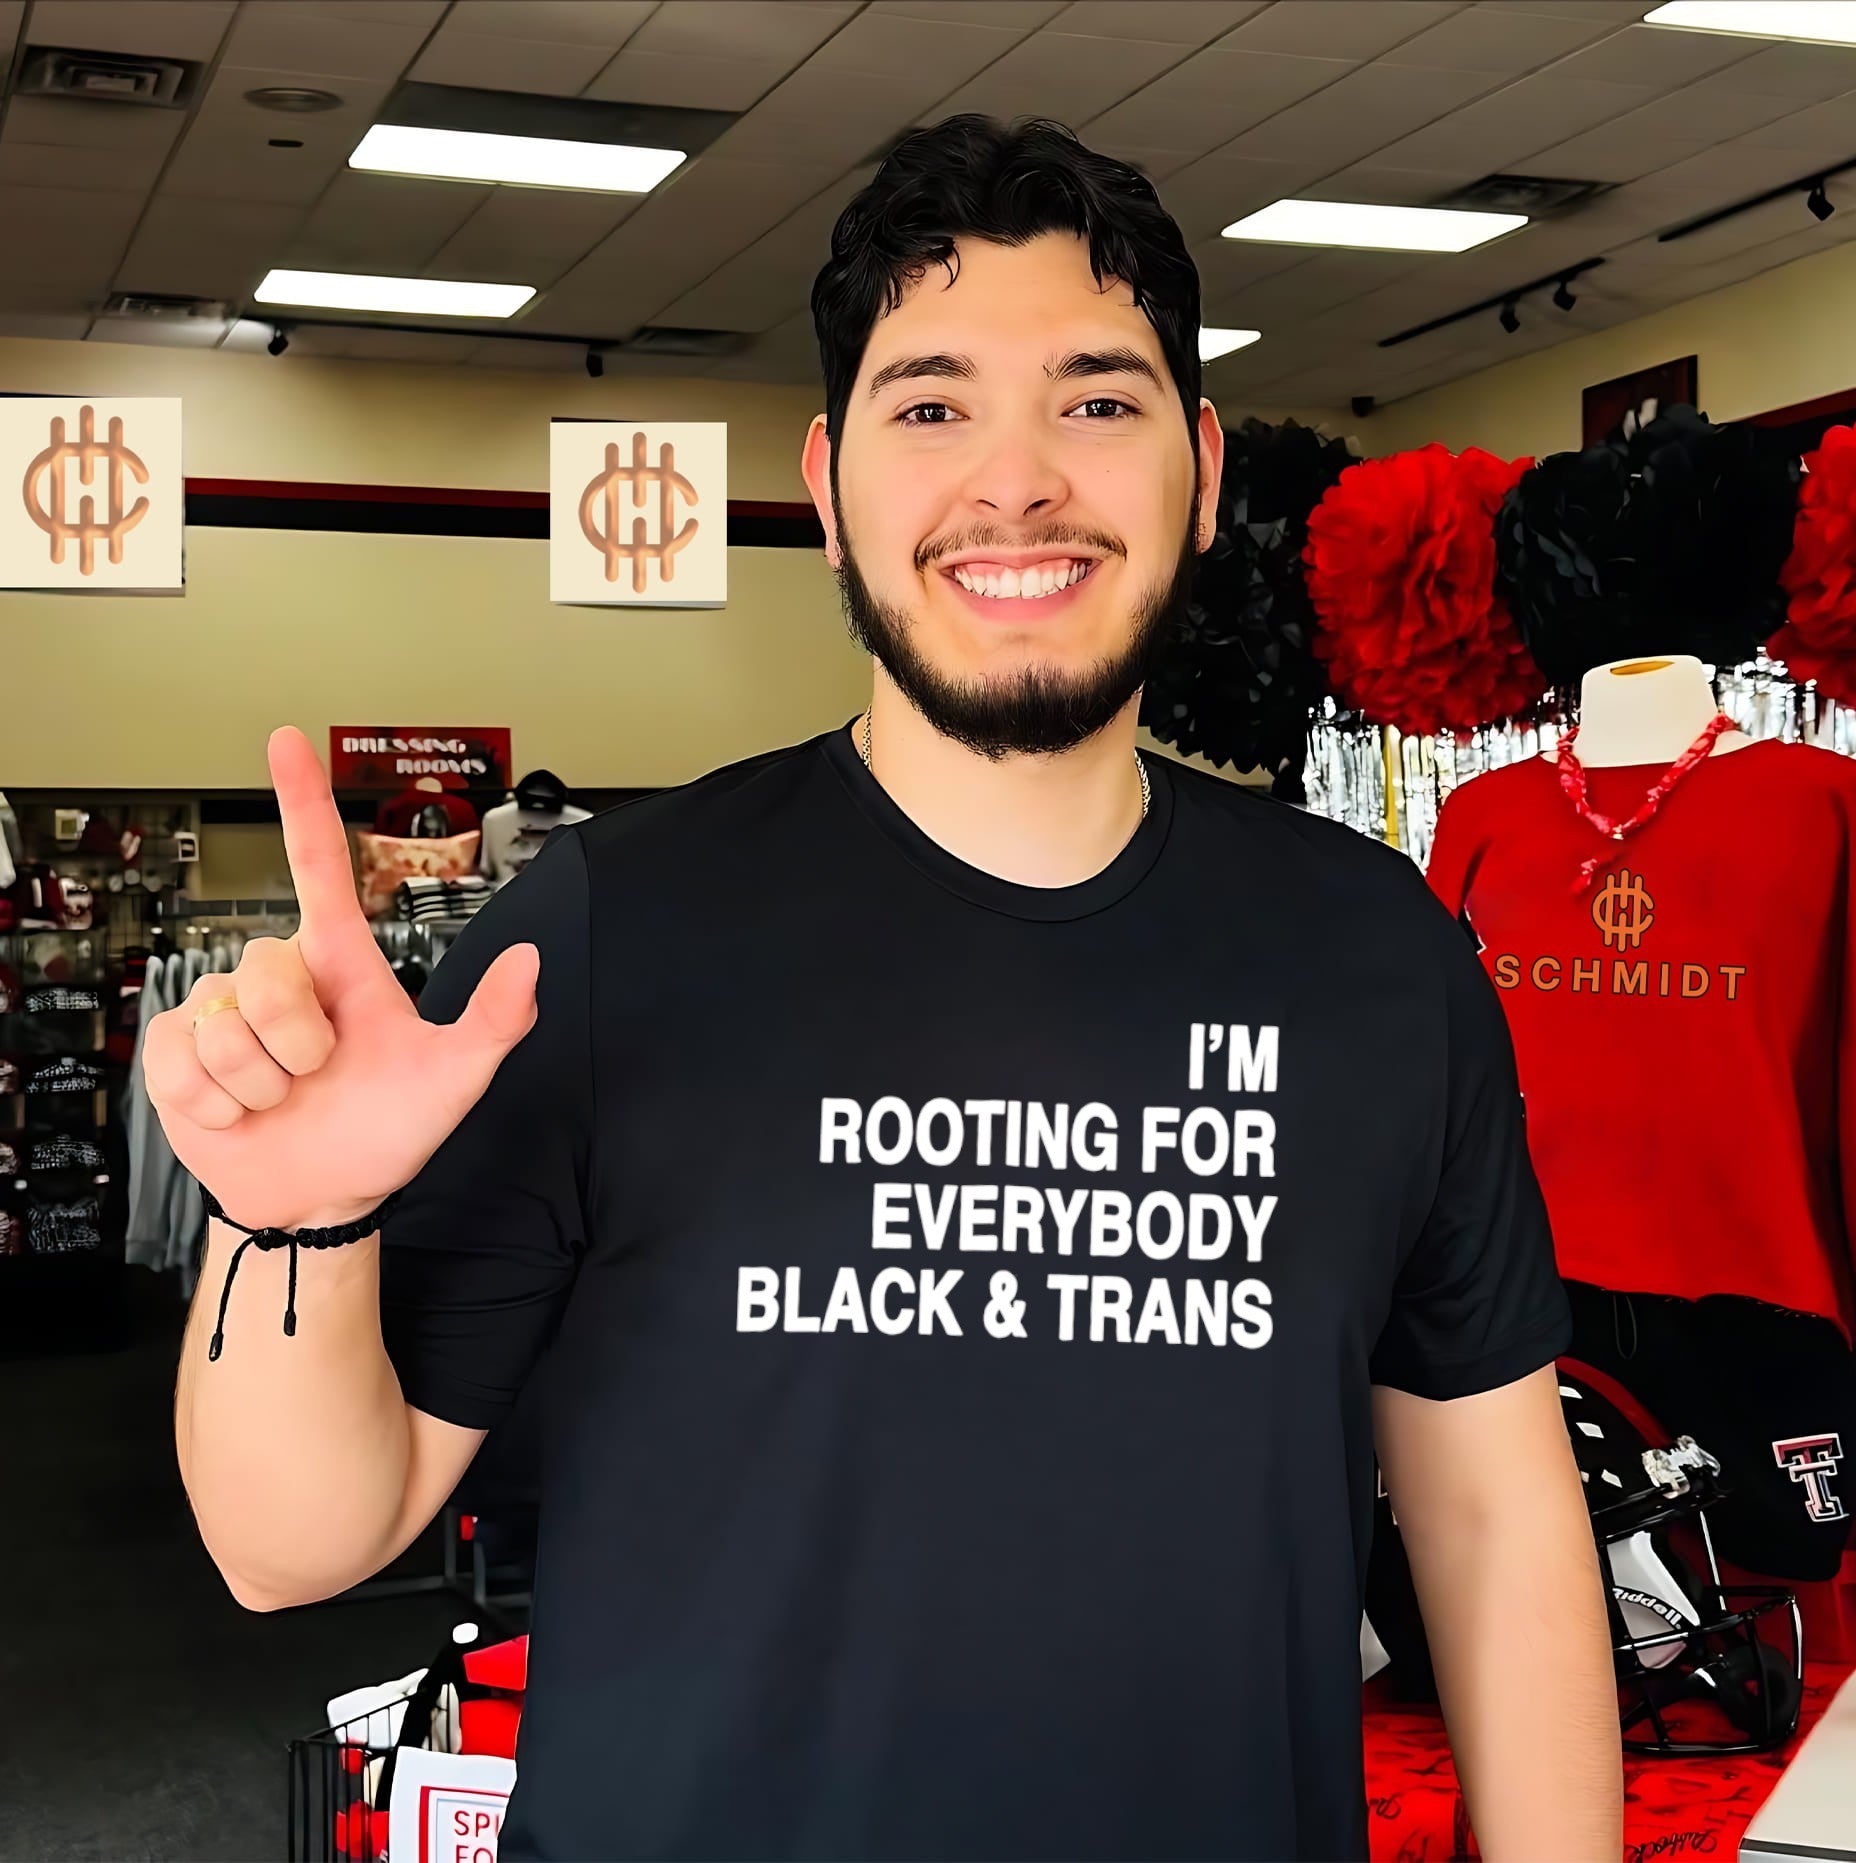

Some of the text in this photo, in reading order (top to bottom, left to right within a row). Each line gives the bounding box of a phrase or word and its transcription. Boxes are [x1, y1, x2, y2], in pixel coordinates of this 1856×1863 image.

[396, 759, 487, 774] ROOMS
[1494, 954, 1746, 1000] SCHMIDT
[1189, 1023, 1279, 1092] I'M
[819, 1096, 1276, 1177] ROOTING FOR
[872, 1183, 1278, 1262] EVERYBODY
[736, 1266, 1273, 1349] BLACK & TRANS
